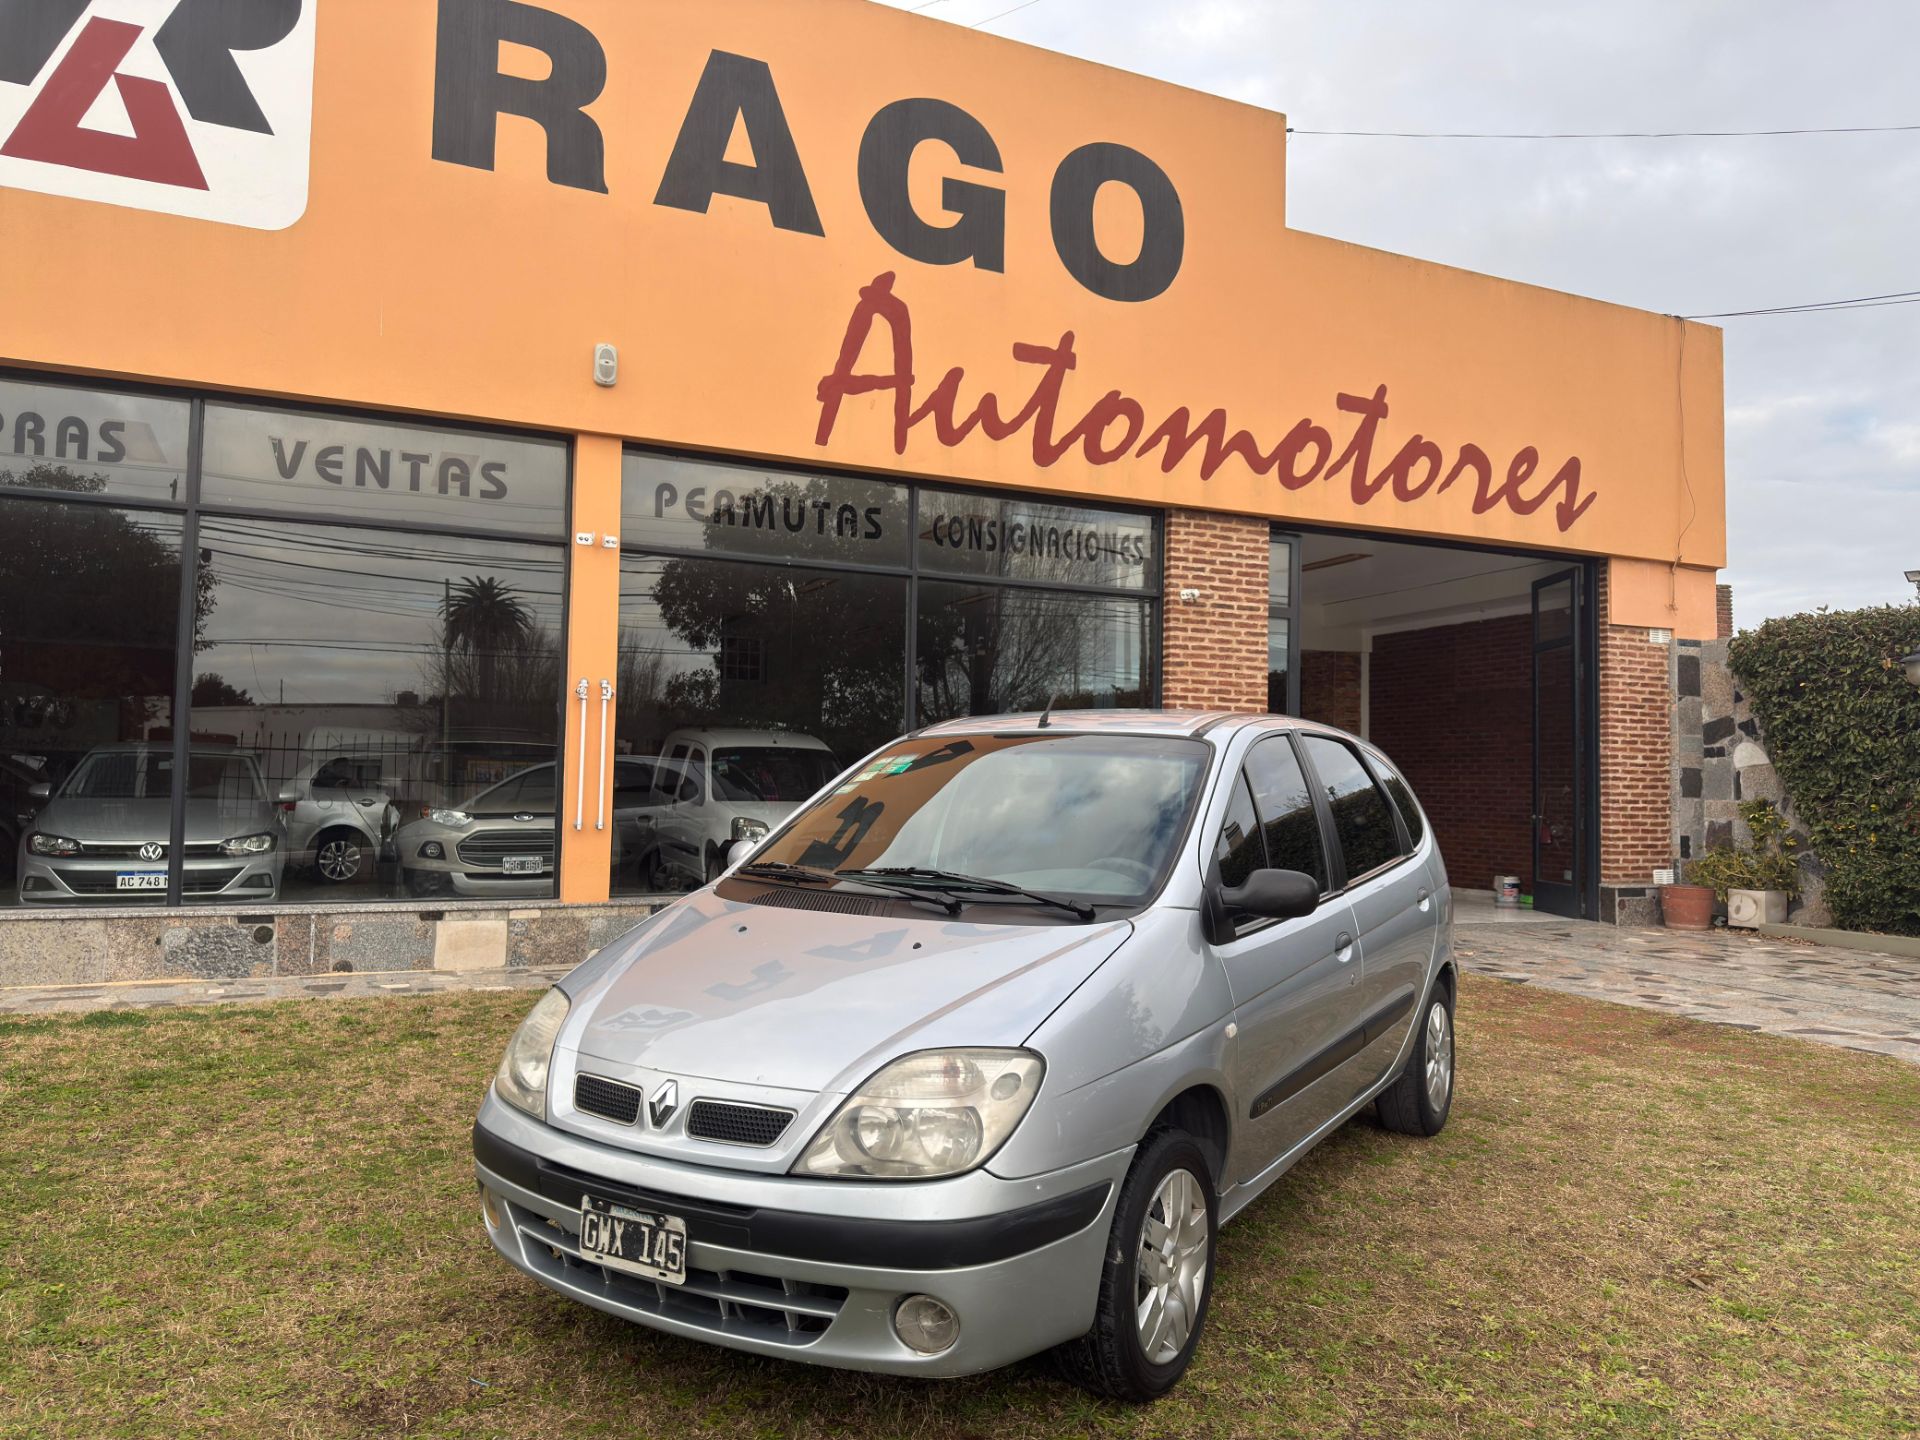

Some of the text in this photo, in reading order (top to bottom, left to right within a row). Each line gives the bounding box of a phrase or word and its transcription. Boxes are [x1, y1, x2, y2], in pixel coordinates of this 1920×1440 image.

[432, 0, 1185, 303] RAGO
[814, 270, 1598, 533] Automotores
[0, 410, 127, 463] RAS
[270, 437, 509, 500] VENTAS
[932, 514, 1145, 567] CONSIGNACIONES
[119, 876, 135, 888] AC
[138, 876, 161, 888] 748
[583, 1213, 683, 1271] GWX 145
